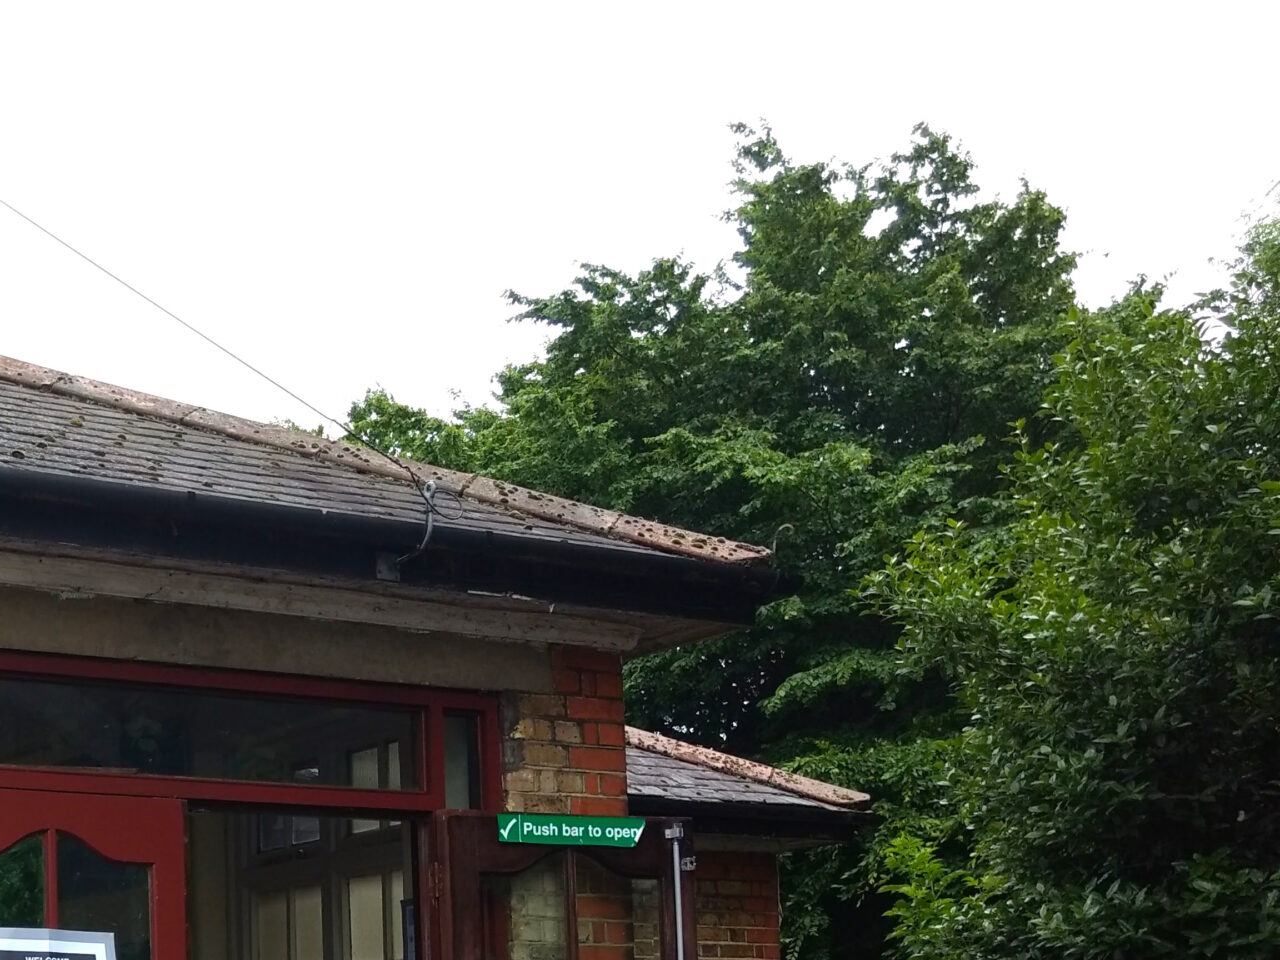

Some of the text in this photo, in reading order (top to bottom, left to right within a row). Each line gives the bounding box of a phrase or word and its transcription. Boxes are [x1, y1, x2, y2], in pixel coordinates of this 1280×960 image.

[523, 823, 640, 841] Push bar to open
